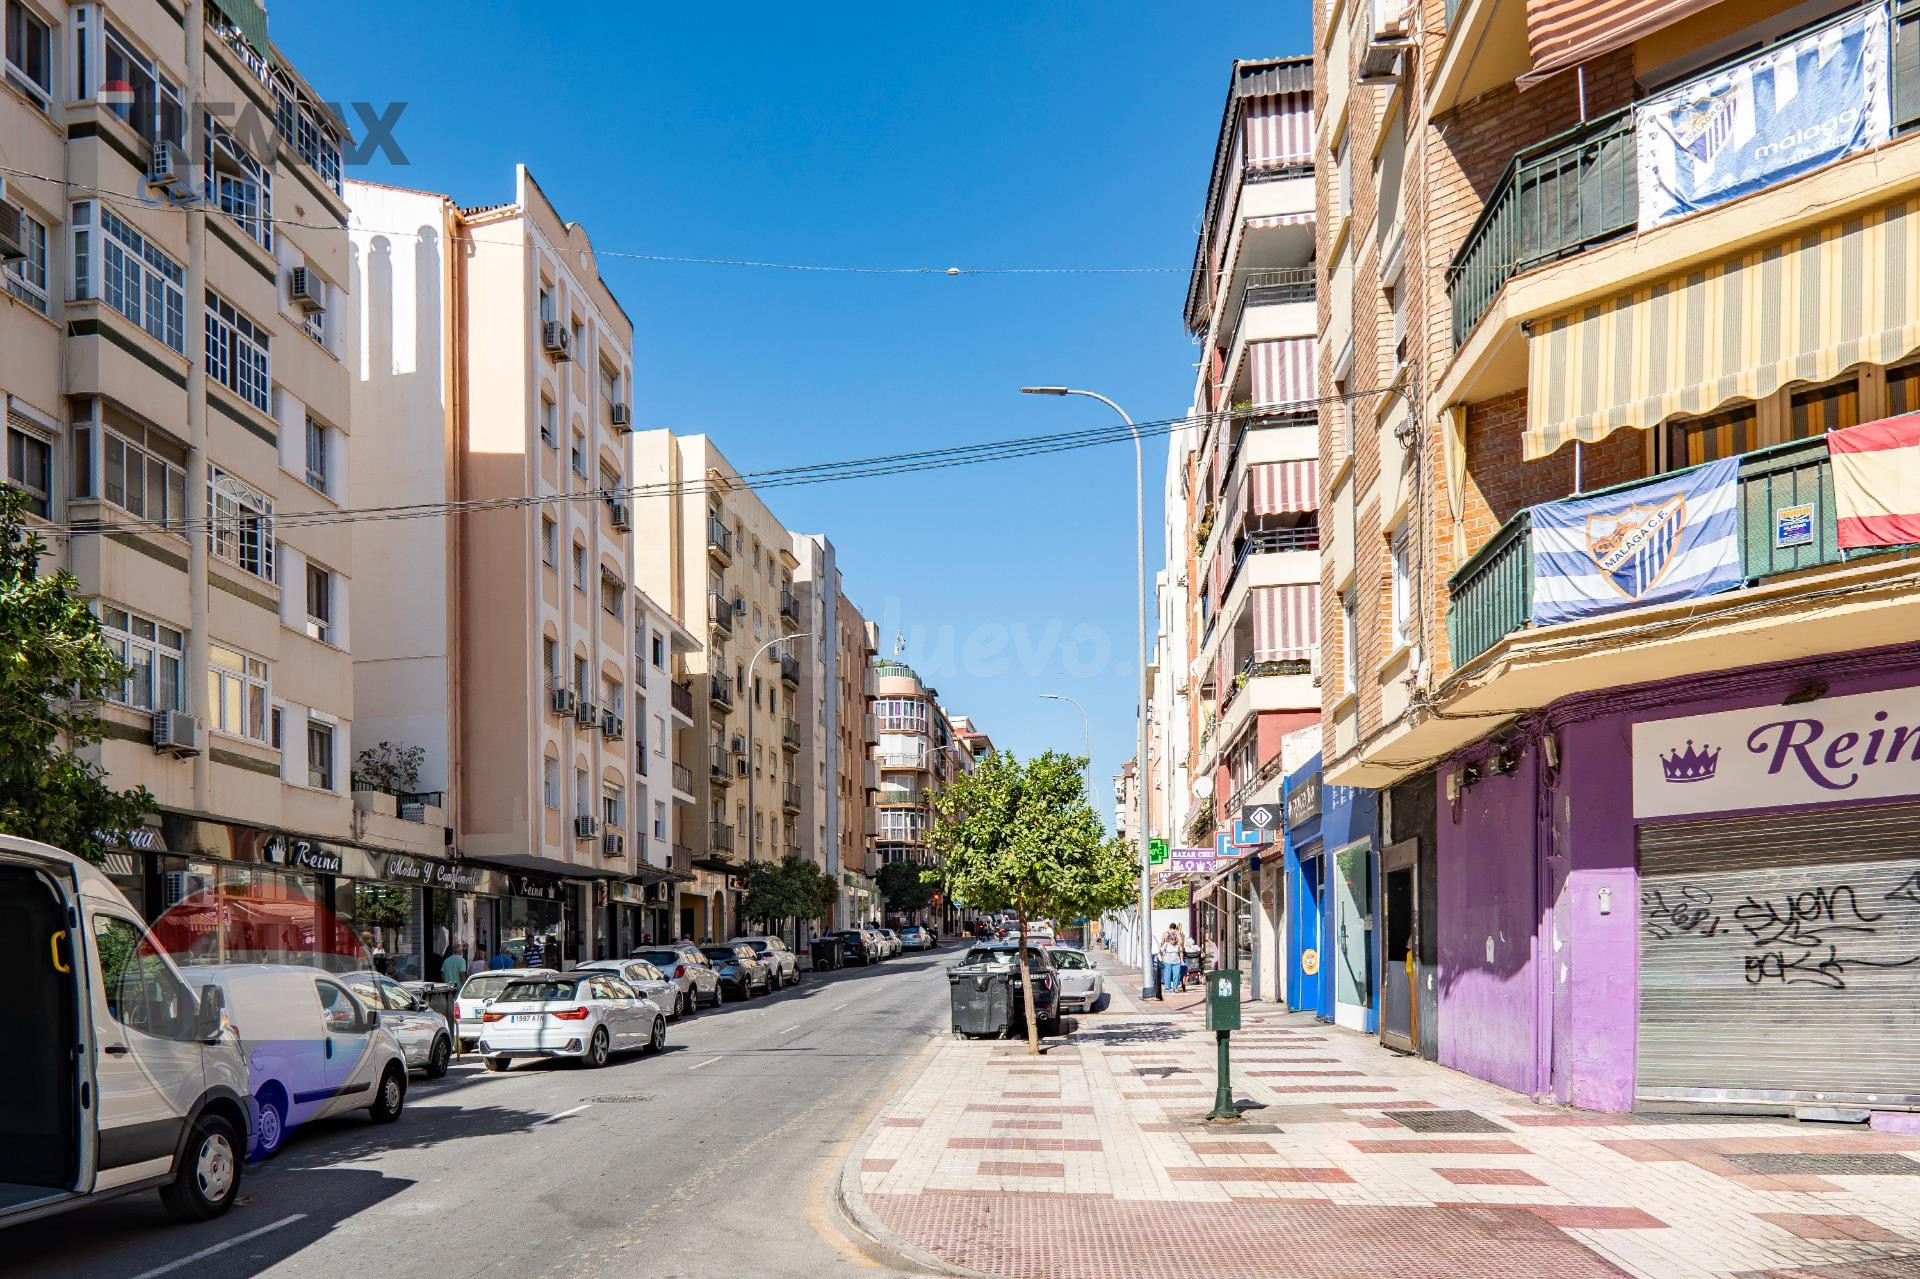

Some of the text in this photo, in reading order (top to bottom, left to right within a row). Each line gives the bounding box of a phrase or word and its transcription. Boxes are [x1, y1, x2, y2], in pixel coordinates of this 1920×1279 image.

[296, 841, 340, 871] Reina
[390, 857, 420, 879] Modas
[521, 876, 543, 898] Reina
